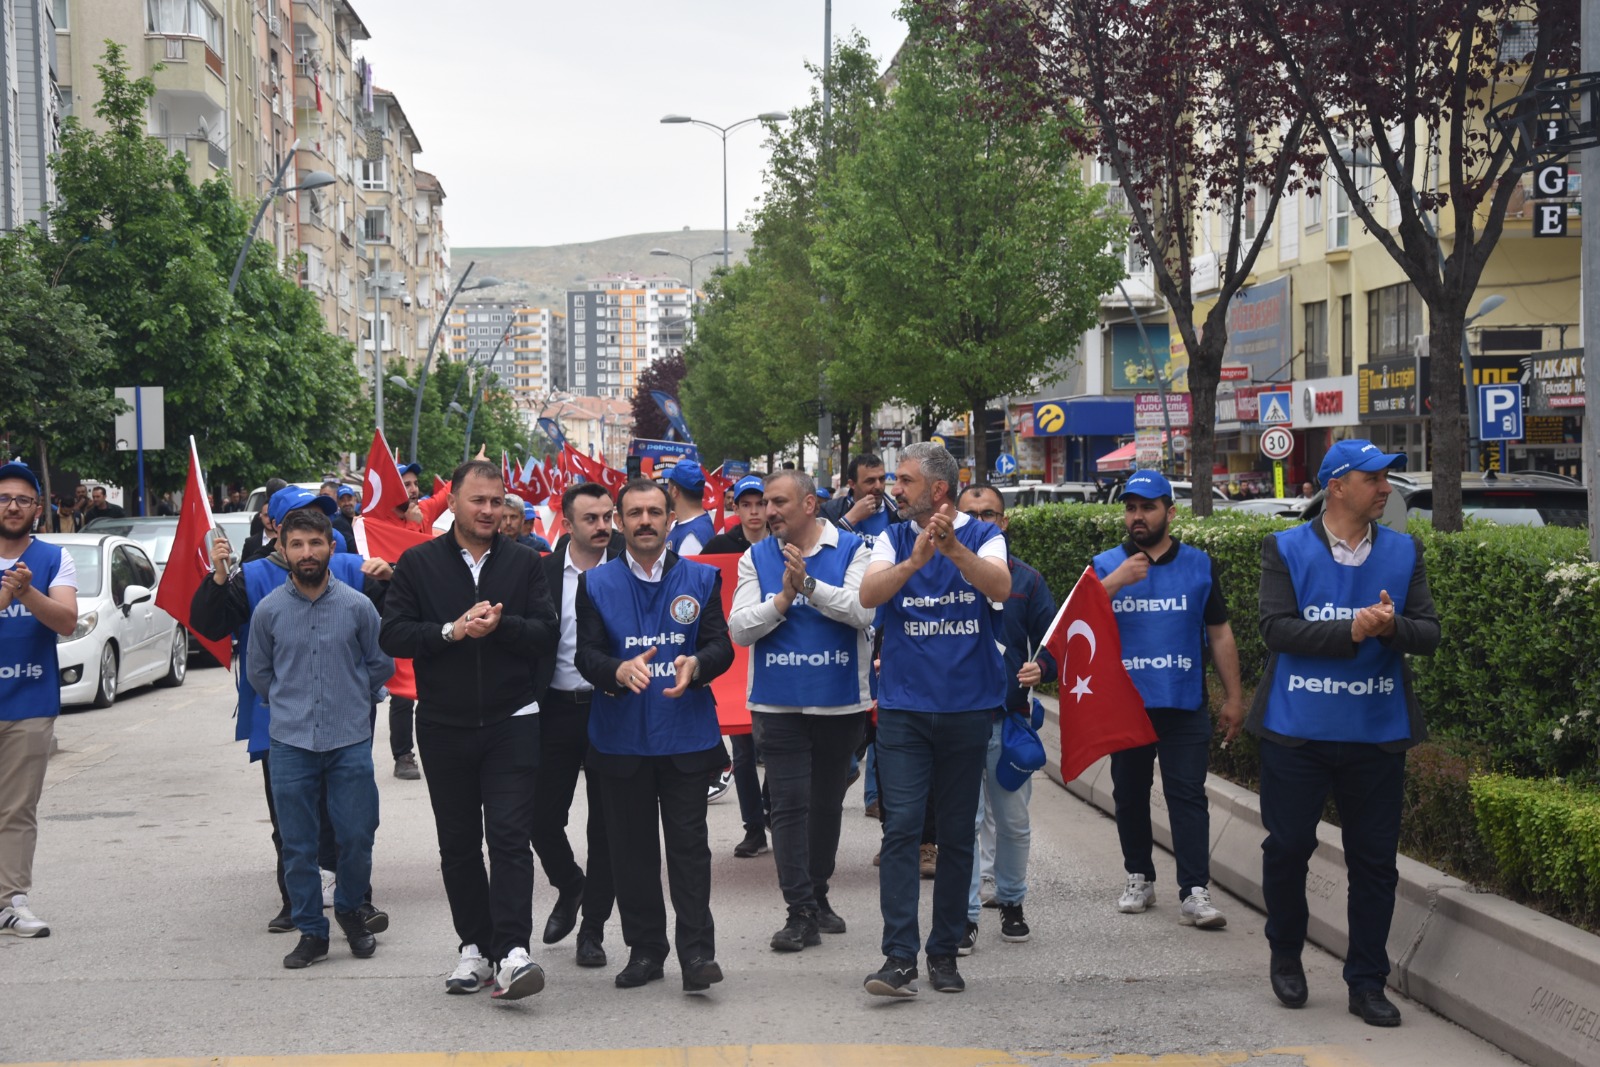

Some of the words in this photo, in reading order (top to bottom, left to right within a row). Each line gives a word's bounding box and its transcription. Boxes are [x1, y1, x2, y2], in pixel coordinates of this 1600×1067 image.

[1534, 356, 1577, 379] HAKAN
[1542, 379, 1572, 396] Teknoloji
[1486, 389, 1515, 422] P
[1268, 435, 1285, 450] 30
[902, 590, 976, 608] petrol-iş
[1112, 594, 1187, 613] GÖREVLİ
[903, 618, 980, 637] SENDİKASI
[765, 649, 850, 668] petrol-iş
[1288, 673, 1395, 696] petrol-iş
